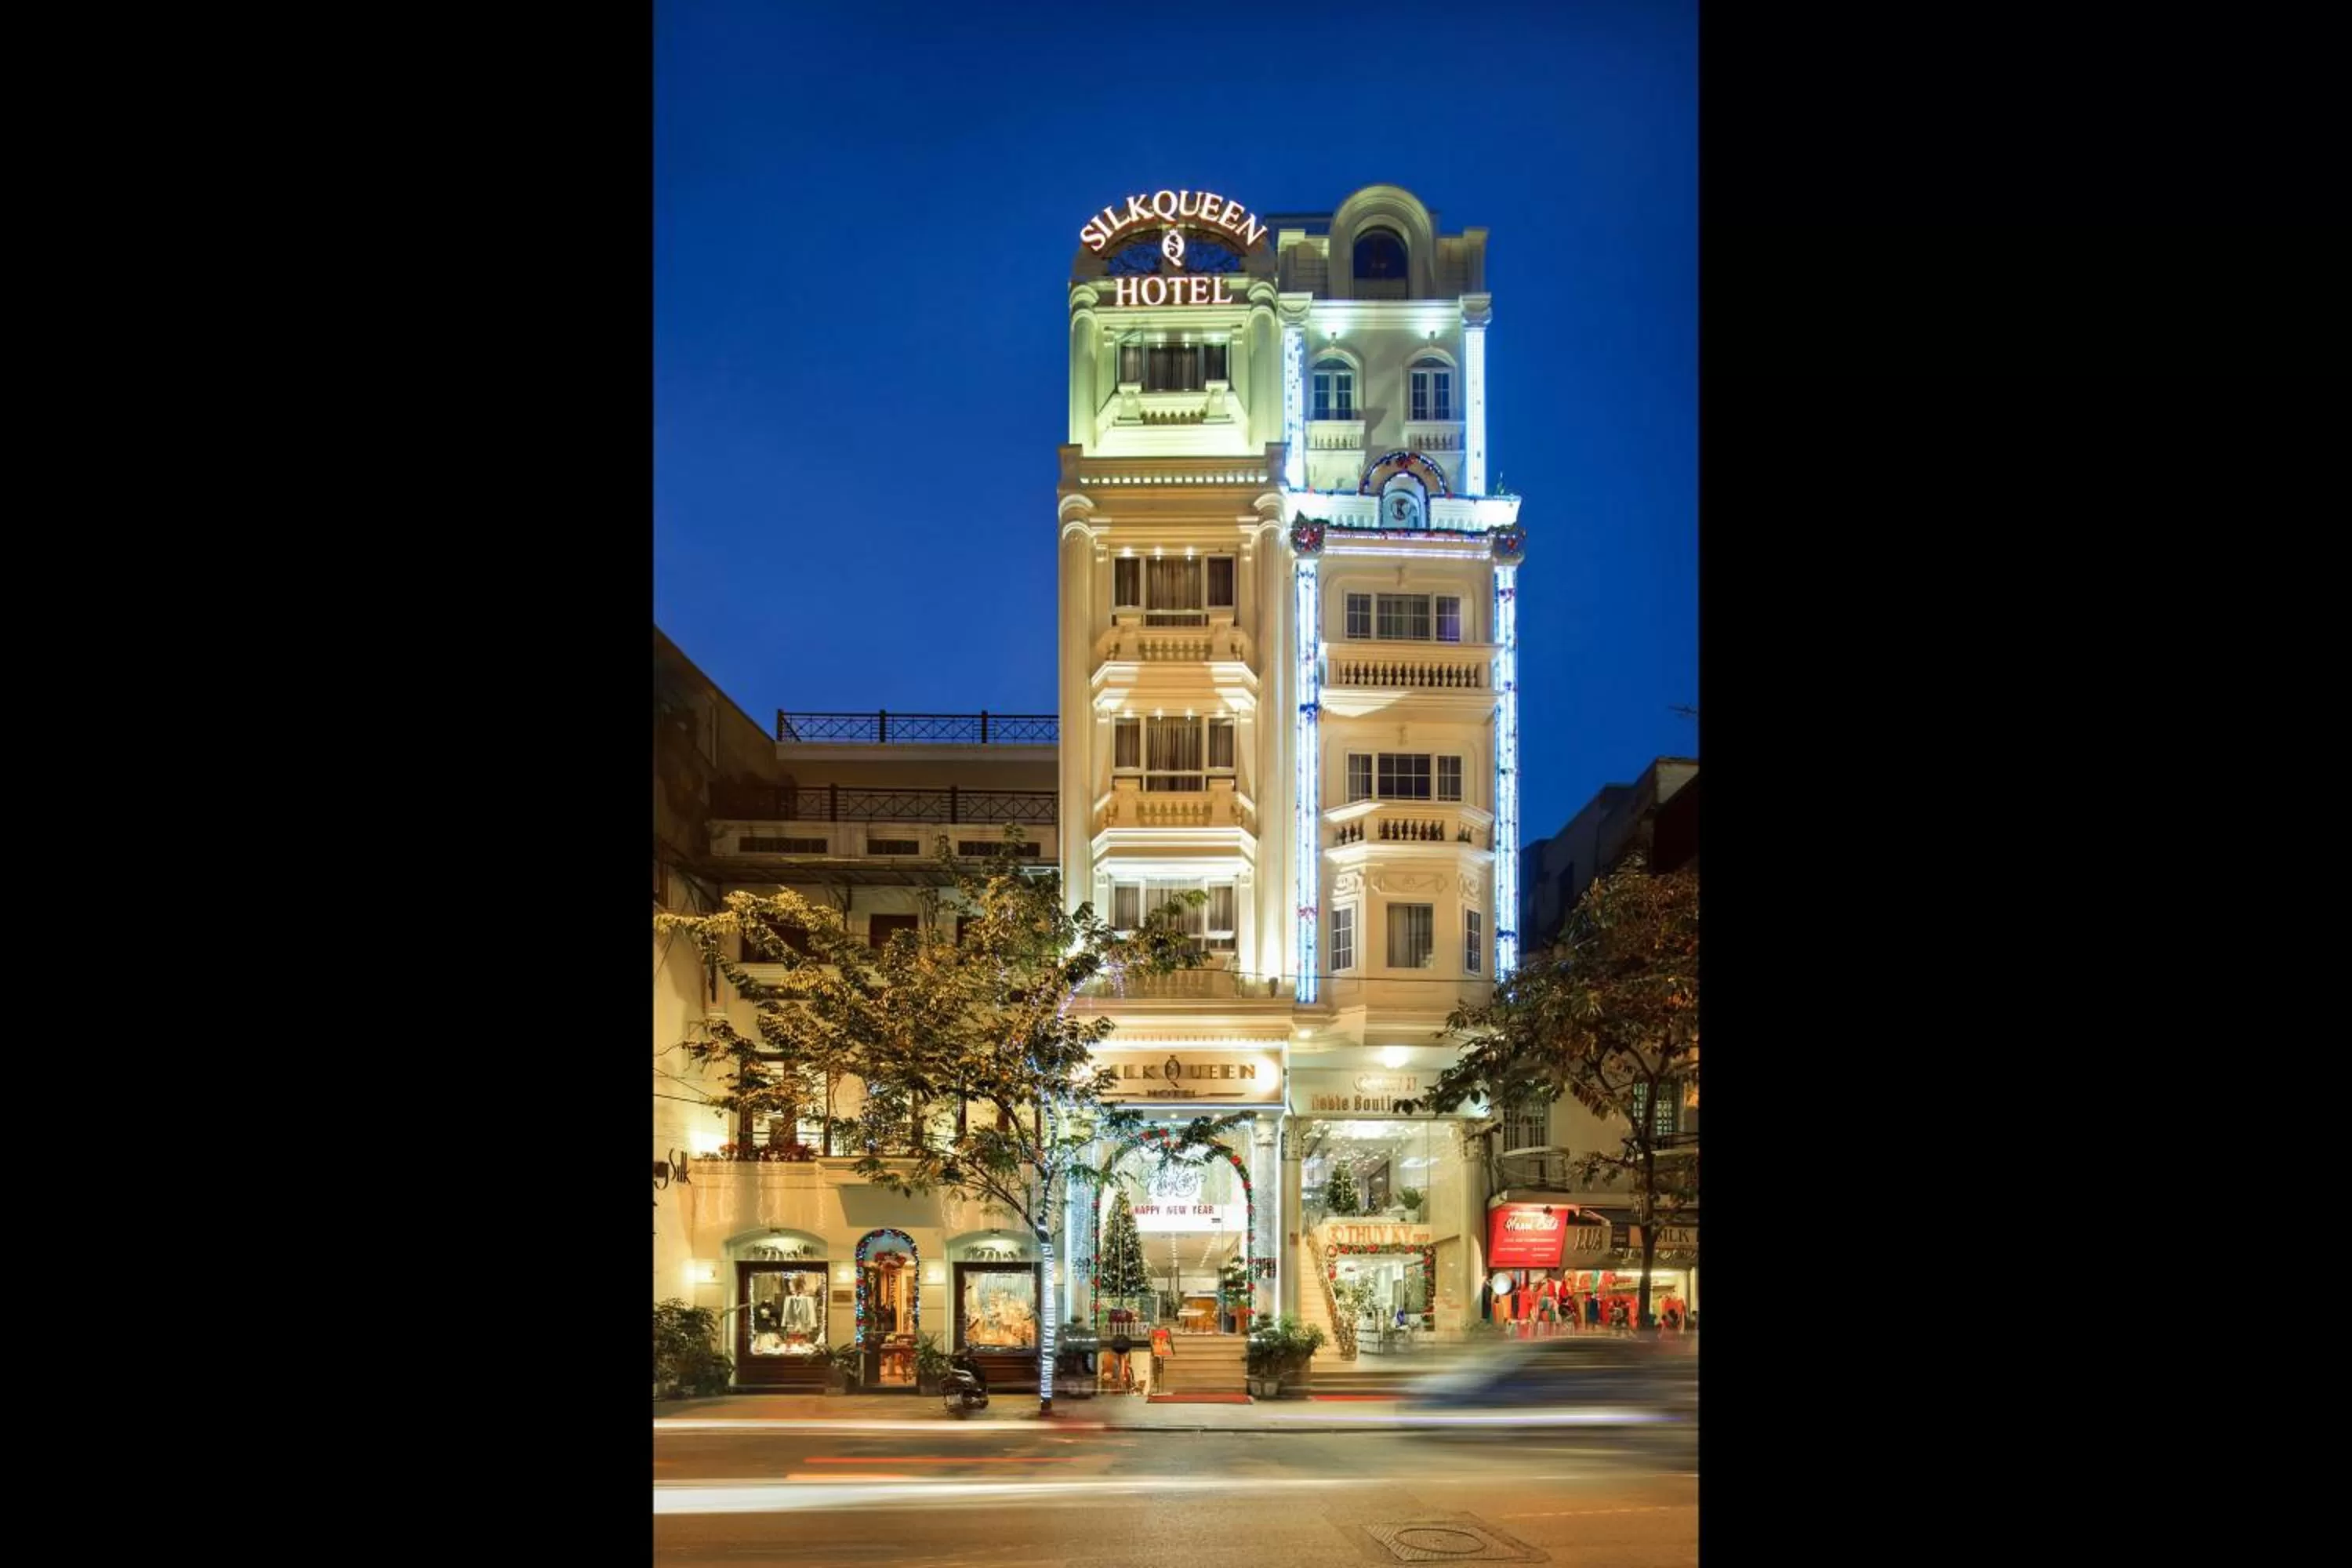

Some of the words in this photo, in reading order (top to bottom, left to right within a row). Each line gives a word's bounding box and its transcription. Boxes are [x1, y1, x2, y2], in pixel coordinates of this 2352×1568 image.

[1080, 190, 1267, 252] SILKQUEEN
[1115, 277, 1233, 306] HOTEL
[1134, 1205, 1160, 1214] HAPPY
[1167, 1205, 1187, 1214] NEW
[1192, 1205, 1214, 1214] YEAR
